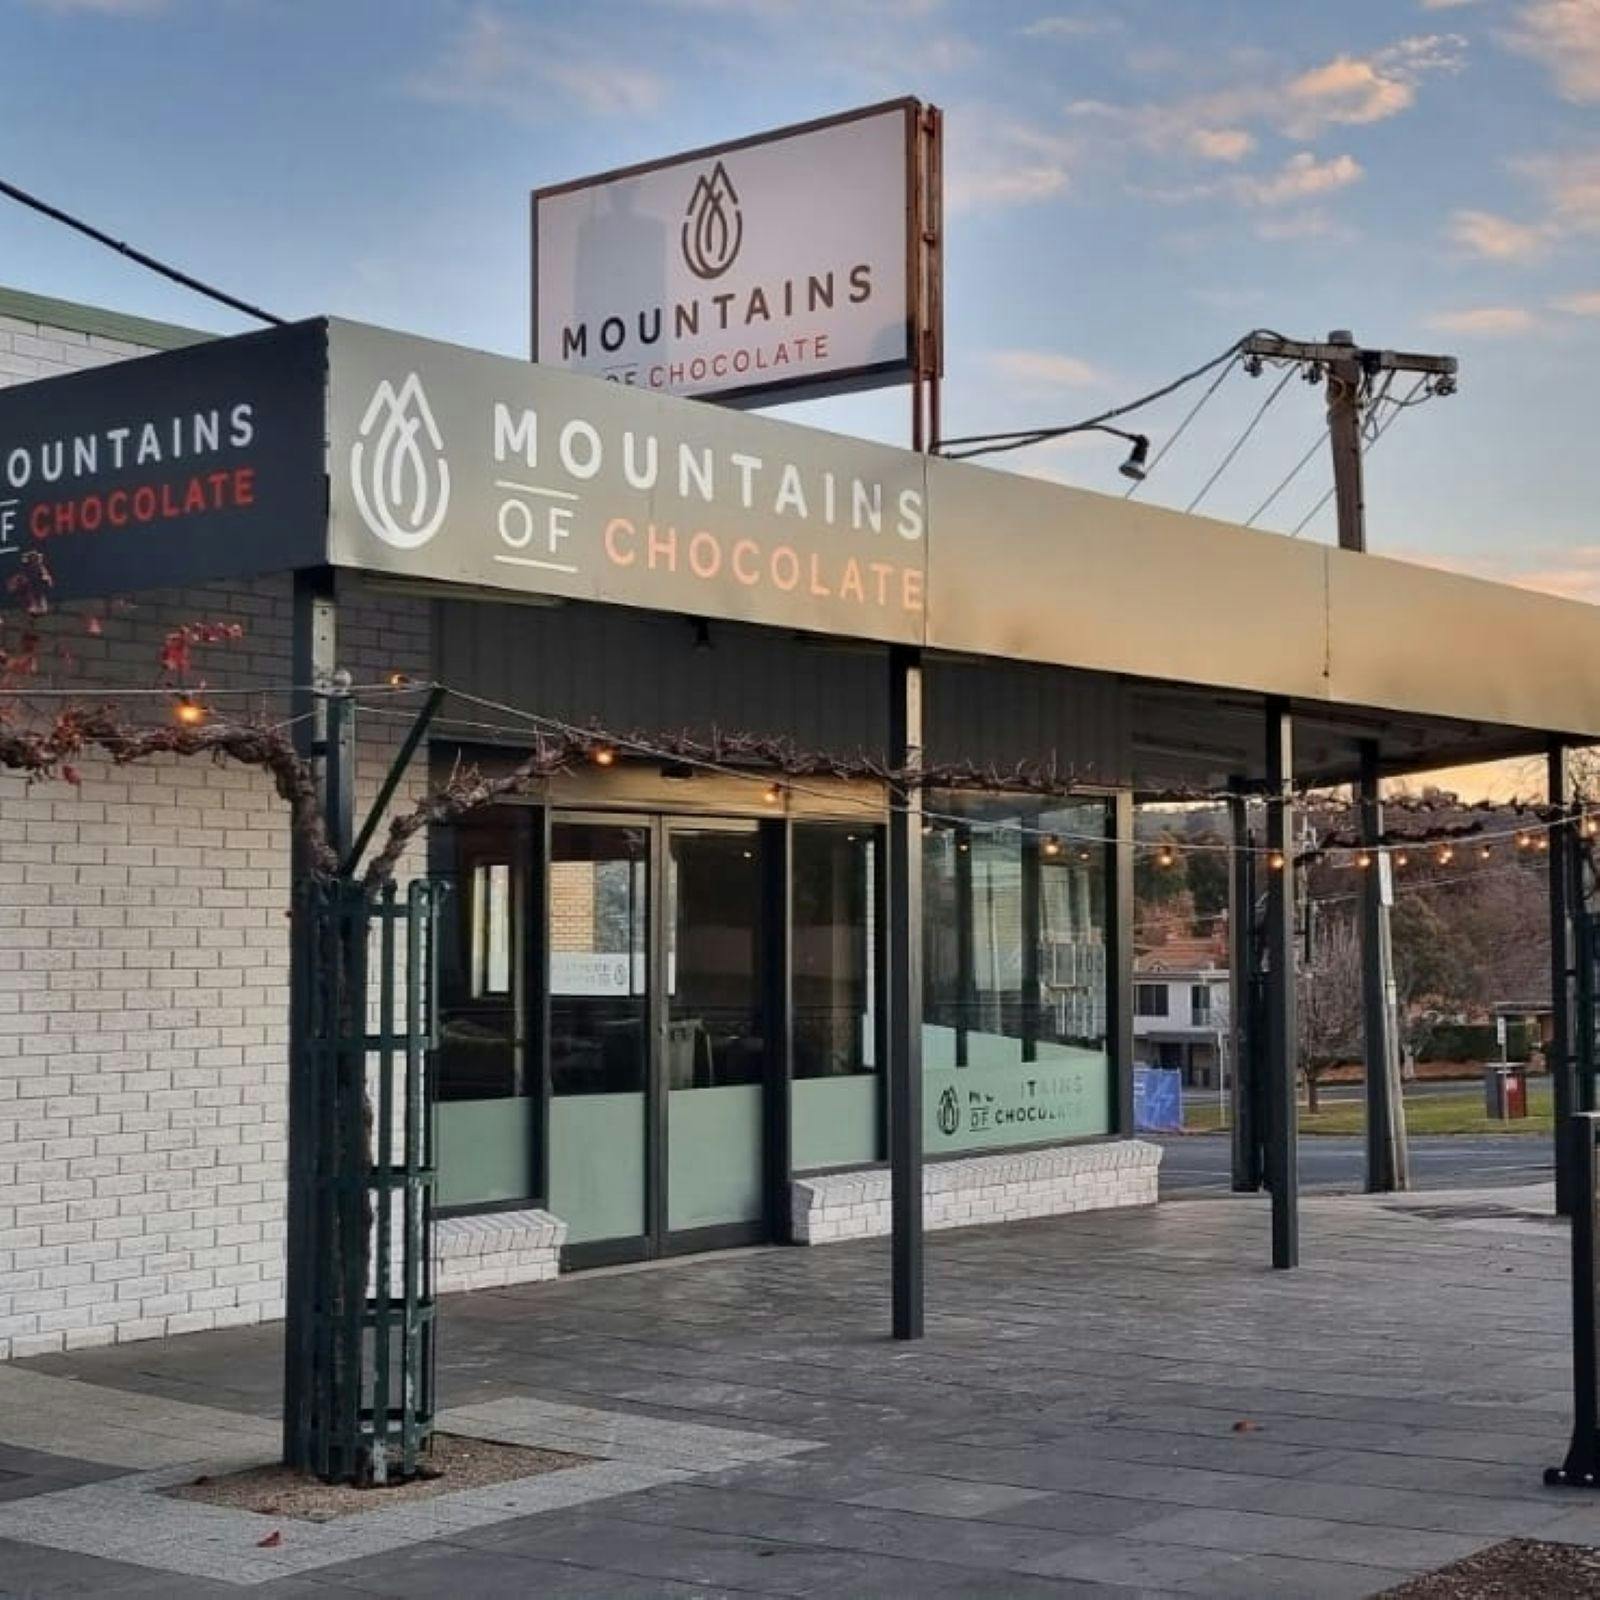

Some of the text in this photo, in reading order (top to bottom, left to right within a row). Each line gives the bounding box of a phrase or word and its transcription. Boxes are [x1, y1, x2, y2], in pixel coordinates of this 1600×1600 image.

[562, 264, 873, 360] MOUNTAINS
[650, 335, 830, 388] CHOCOLATE
[7, 403, 254, 488] OUNTAINS
[493, 402, 925, 540] MOUNTAINS
[0, 467, 256, 543] F CHOCOLATE
[498, 499, 925, 611] OF CHOCOLATE
[970, 1110, 990, 1128] OF
